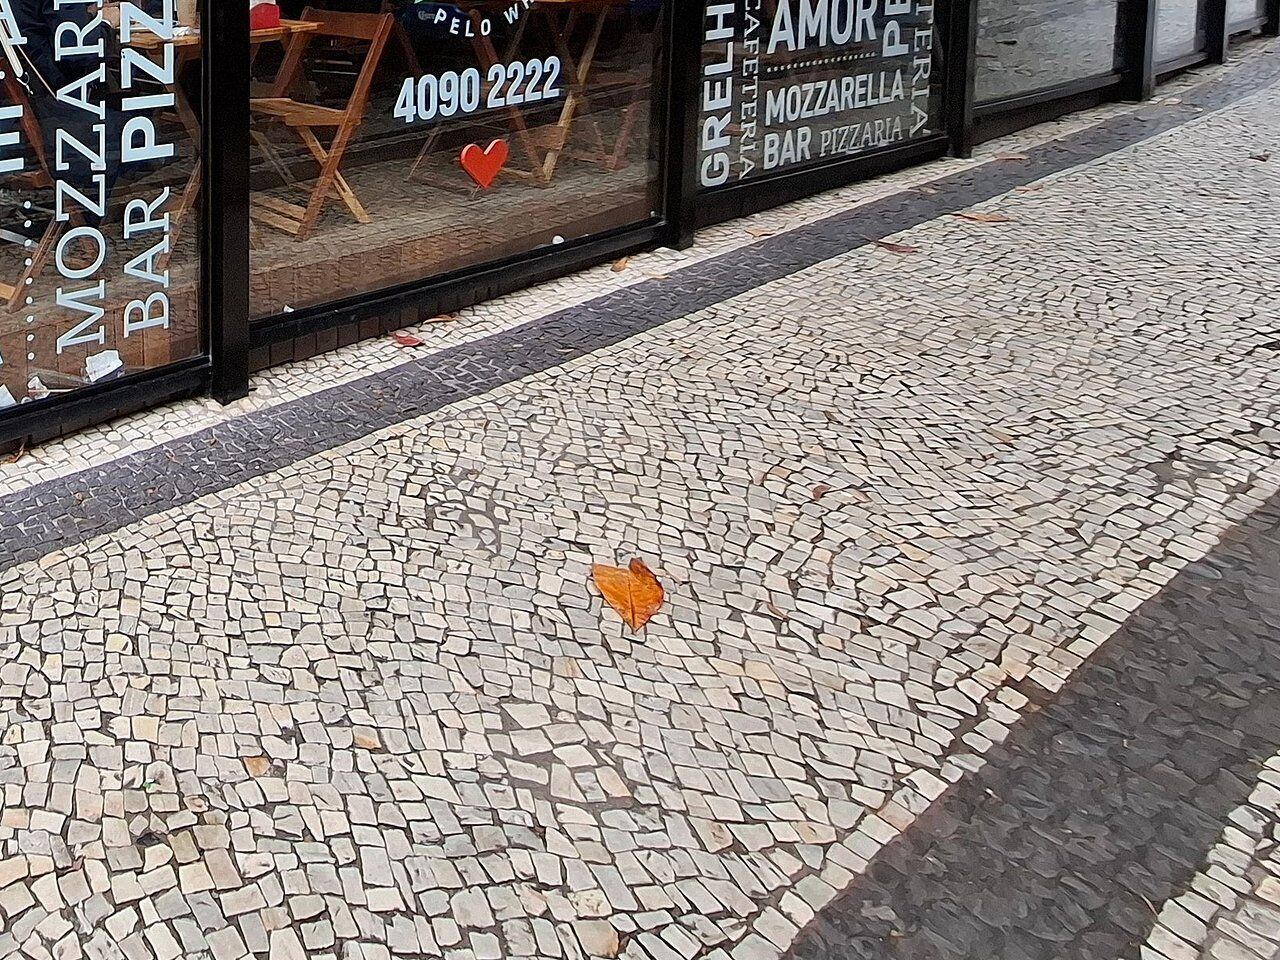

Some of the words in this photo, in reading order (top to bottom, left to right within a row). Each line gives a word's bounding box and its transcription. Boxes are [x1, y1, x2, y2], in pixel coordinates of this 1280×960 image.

[433, 7, 492, 38] PELO
[394, 71, 481, 124] 4090
[486, 55, 561, 109] 2222
[765, 69, 905, 126] MOZZARELLA
[763, 127, 813, 170] BAR
[819, 115, 904, 158] PIZZARIA
[123, 186, 170, 339] BAR
